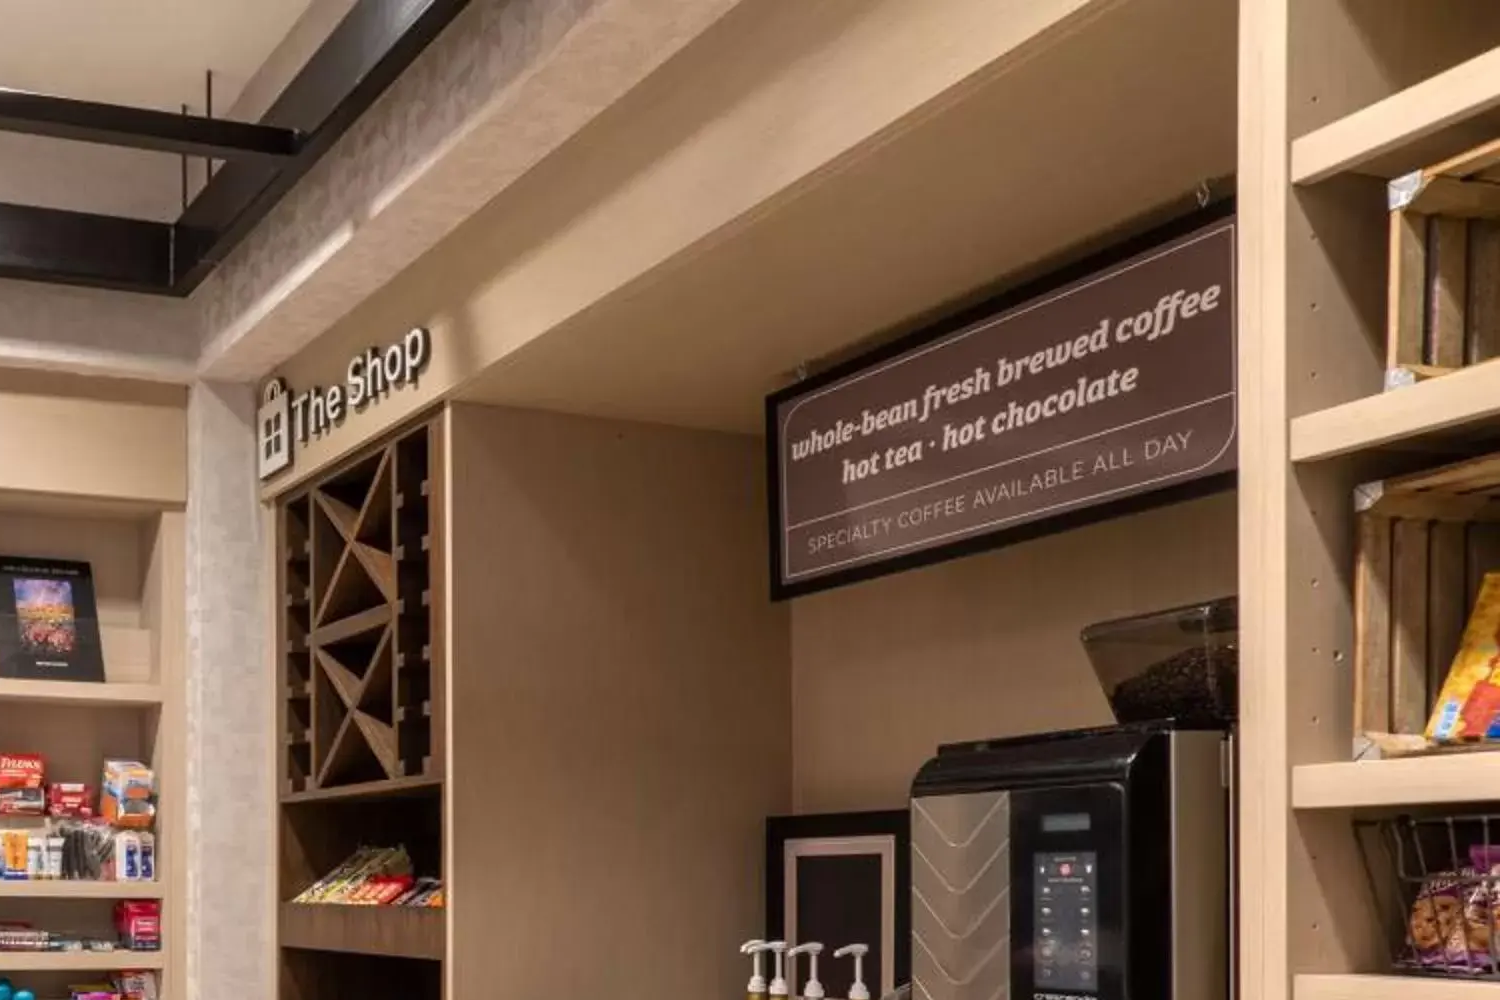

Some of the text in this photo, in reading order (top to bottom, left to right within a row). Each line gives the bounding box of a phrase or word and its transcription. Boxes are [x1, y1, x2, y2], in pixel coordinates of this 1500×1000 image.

[292, 327, 425, 441] The Shop
[792, 284, 1221, 461] whole-bean fresh brewed coffee
[842, 367, 1140, 484] hot tea hot chocolate
[807, 430, 1194, 555] SPECIALTY COFFEE AVAILABLE ALL DAY
